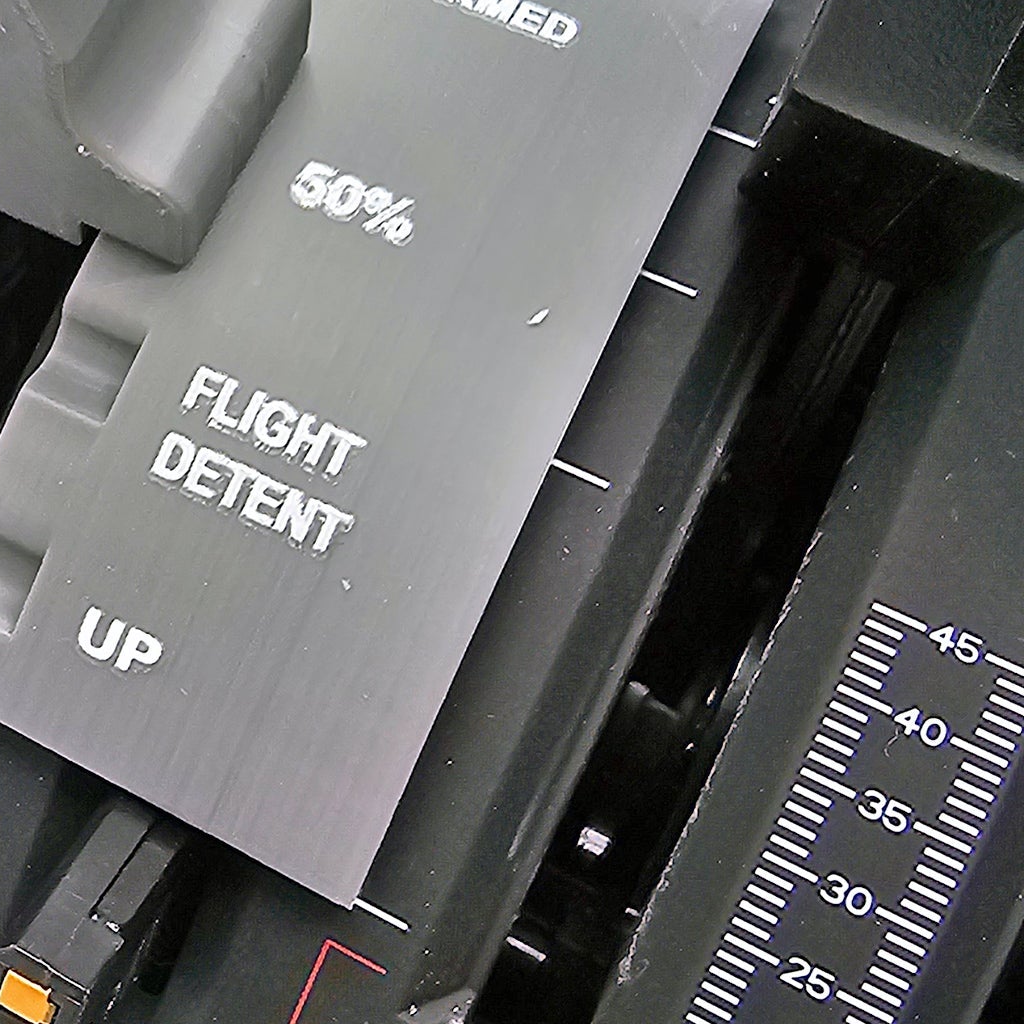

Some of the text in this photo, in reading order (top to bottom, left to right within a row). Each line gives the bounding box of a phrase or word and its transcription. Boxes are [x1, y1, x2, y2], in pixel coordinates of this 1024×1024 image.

[290, 161, 416, 247] 50%
[181, 365, 367, 478] FLIGHT
[149, 431, 355, 556] DETENT
[77, 606, 164, 673] UP
[928, 625, 984, 664] 45
[894, 708, 948, 748] 40
[857, 789, 913, 834] 35
[820, 873, 873, 917] 30
[779, 956, 836, 1002] 25
